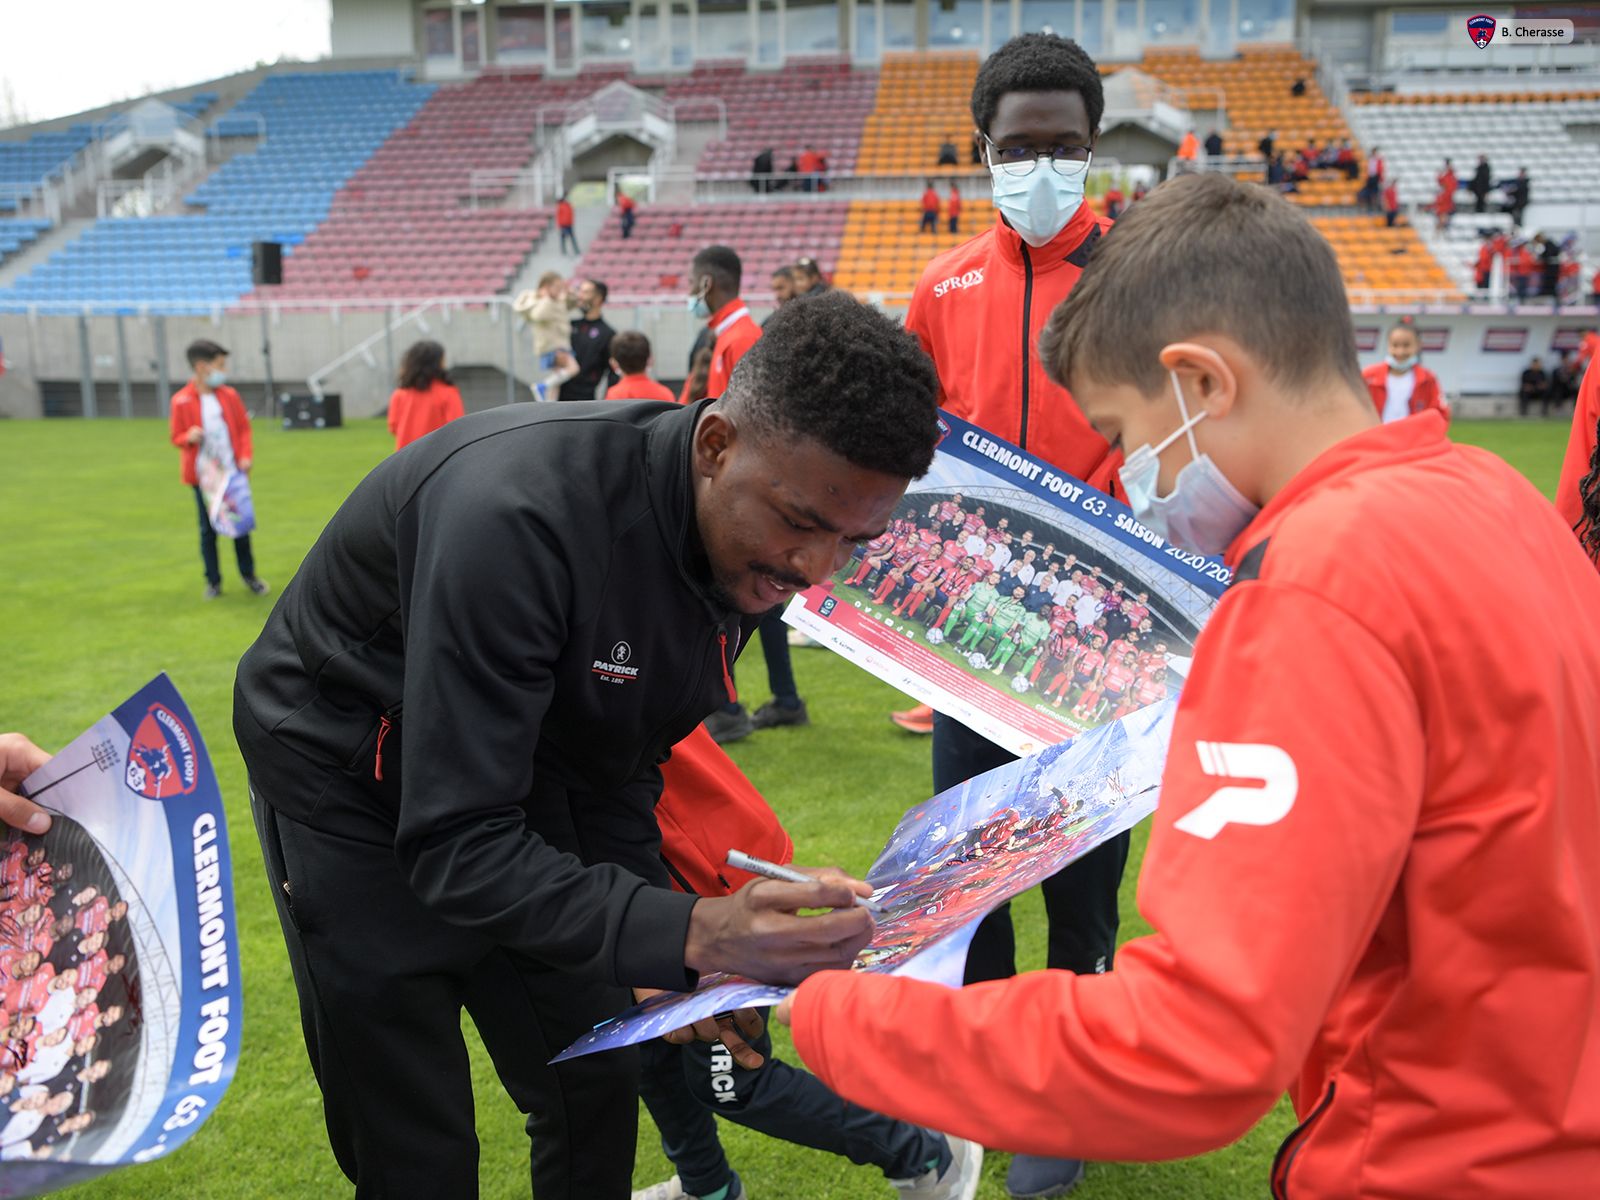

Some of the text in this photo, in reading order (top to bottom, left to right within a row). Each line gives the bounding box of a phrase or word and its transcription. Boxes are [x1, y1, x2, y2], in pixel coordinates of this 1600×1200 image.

[962, 430, 1042, 481] CLERMONT
[1040, 471, 1083, 503] FOOT
[1082, 496, 1107, 516] 63
[1114, 513, 1165, 549] SAISON
[1164, 544, 1234, 586] 2020/202
[592, 660, 639, 676] PATRICK
[129, 767, 141, 787] 63
[156, 709, 194, 784] CLERMONT FOOT
[192, 812, 229, 990] CLERMONT
[188, 996, 230, 1086] FOOT
[710, 1038, 739, 1104] TRICK
[162, 1094, 207, 1131] 63
